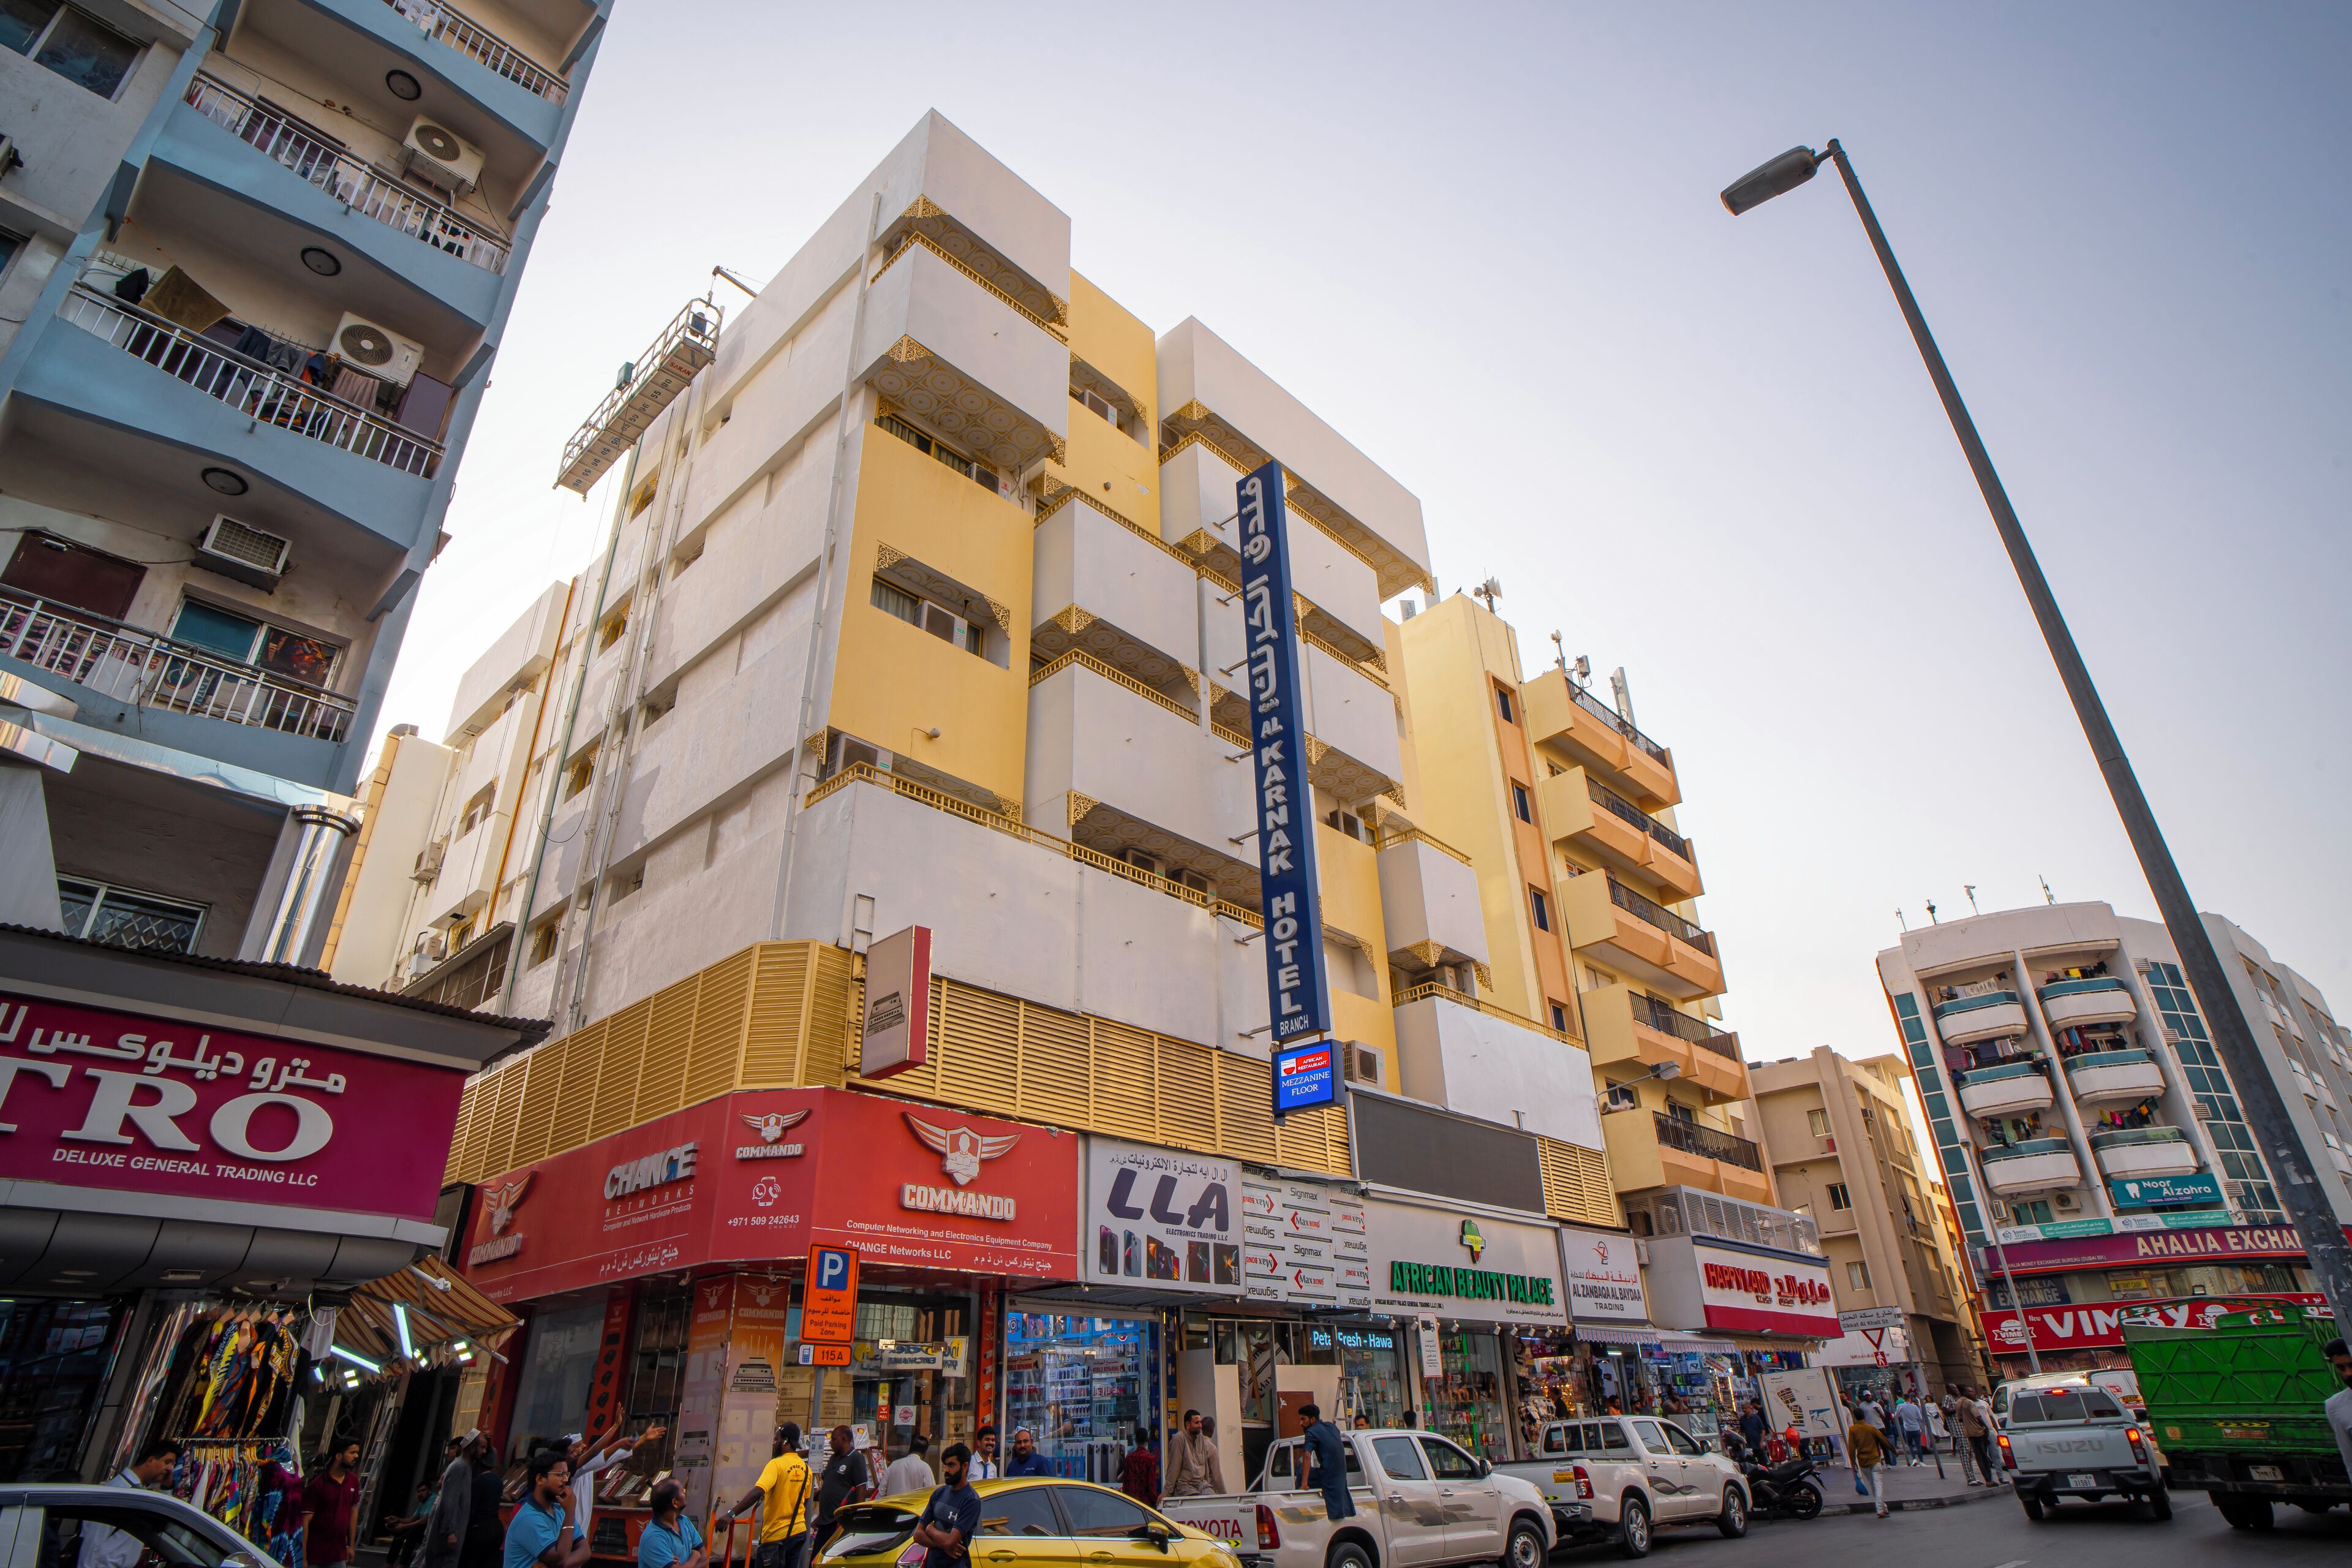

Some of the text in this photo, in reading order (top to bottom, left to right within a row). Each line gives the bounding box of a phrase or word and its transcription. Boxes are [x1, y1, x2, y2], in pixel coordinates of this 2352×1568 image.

[669, 362, 692, 376] SAKAN
[650, 390, 662, 399] 55
[1261, 716, 1302, 1016] AL KARNAK HOTEL
[1280, 1014, 1309, 1036] BRANCH
[28, 1028, 347, 1094] مترو ديلوكس
[1298, 1060, 1327, 1071] RESTAURANT
[1303, 1055, 1322, 1064] AFRICAN
[1281, 1071, 1330, 1088] MEZZANINE
[1291, 1084, 1318, 1096] FLOOR
[736, 1144, 802, 1158] COMMANDO
[52, 1148, 318, 1186] DELUXE GENERAL TRADING LLC
[604, 1140, 700, 1200] CHANGE
[1291, 1187, 1318, 1200] Signmax
[2163, 1186, 2212, 1196] Alzahra
[605, 1185, 694, 1217] NETWORKS
[903, 1184, 1015, 1220] COMMANDO
[1107, 1167, 1229, 1232] LLA
[603, 1221, 622, 1232] Computer
[631, 1213, 649, 1224] Network
[649, 1209, 670, 1219] Hardware
[671, 1203, 692, 1215] Products
[728, 1215, 799, 1226] +971 509 242643
[1295, 1216, 1309, 1226] Max
[846, 1219, 1052, 1251] Computer Networking and Electronics Equipment Company
[1166, 1228, 1196, 1238] ELECTRONICS
[1197, 1232, 1216, 1240] TRADING
[1244, 1225, 1275, 1238] Signmax
[470, 1235, 518, 1265] COMMANDO
[1294, 1245, 1322, 1257] Signmax
[2136, 1232, 2222, 1256] AHALIA
[889, 1245, 951, 1260] Networks LLC
[822, 1253, 843, 1286] P
[1299, 1274, 1313, 1284] Max
[1390, 1261, 1555, 1305] AFRICAN BEAUTY PALACE
[503, 1286, 513, 1296] LLC
[820, 1294, 841, 1303] مواقف
[1248, 1287, 1278, 1299] Signmax
[1573, 1284, 1642, 1302] AL ZANBAQA AL BAYDAA
[1997, 1288, 2061, 1306] EXHANGE
[739, 1308, 785, 1318] COMMANDO
[824, 1321, 846, 1330] Parking
[1368, 1333, 1392, 1348] Hawa
[2036, 1439, 2104, 1455] ISUZU
